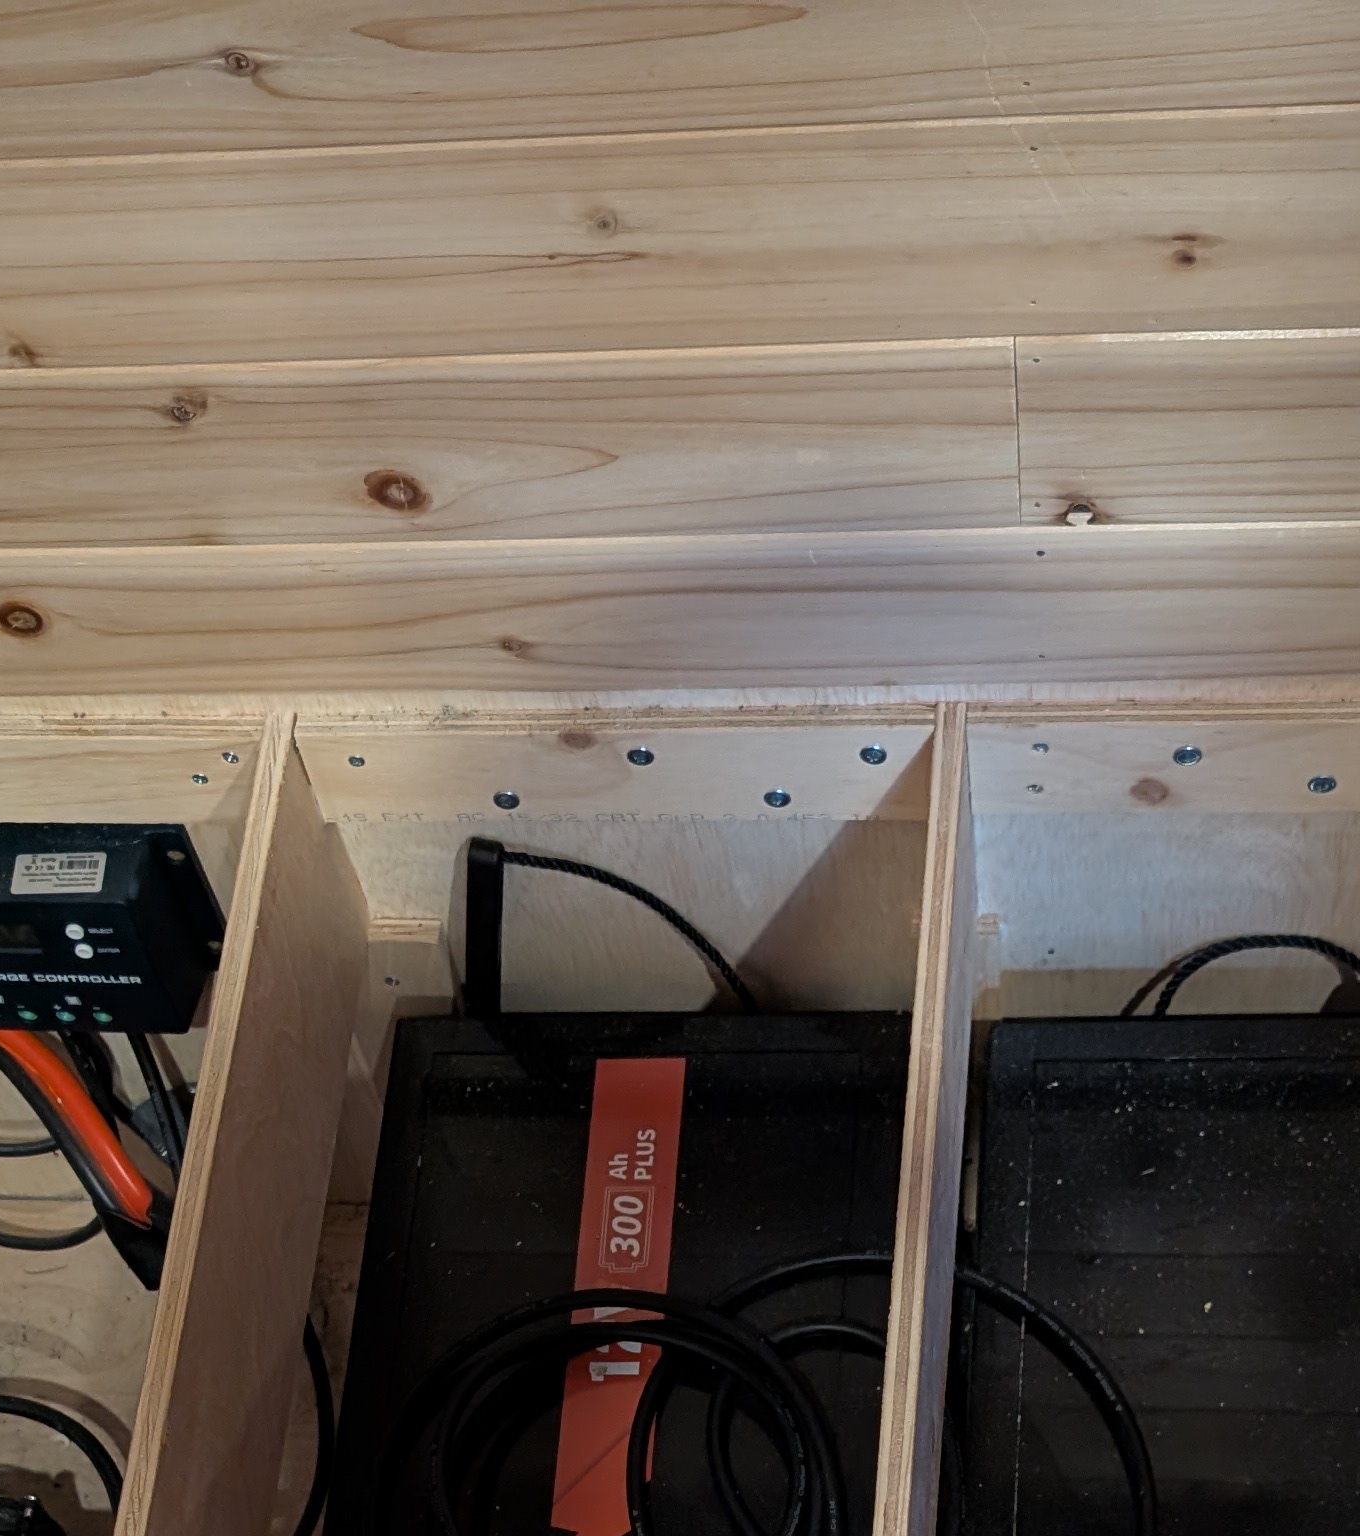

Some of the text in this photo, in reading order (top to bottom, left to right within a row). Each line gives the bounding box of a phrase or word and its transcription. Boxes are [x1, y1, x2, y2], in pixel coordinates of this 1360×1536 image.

[33, 974, 142, 985] CONTROLLER
[608, 1153, 629, 1180] Ah
[634, 1128, 656, 1181] PLUS
[609, 1195, 644, 1258] 300
